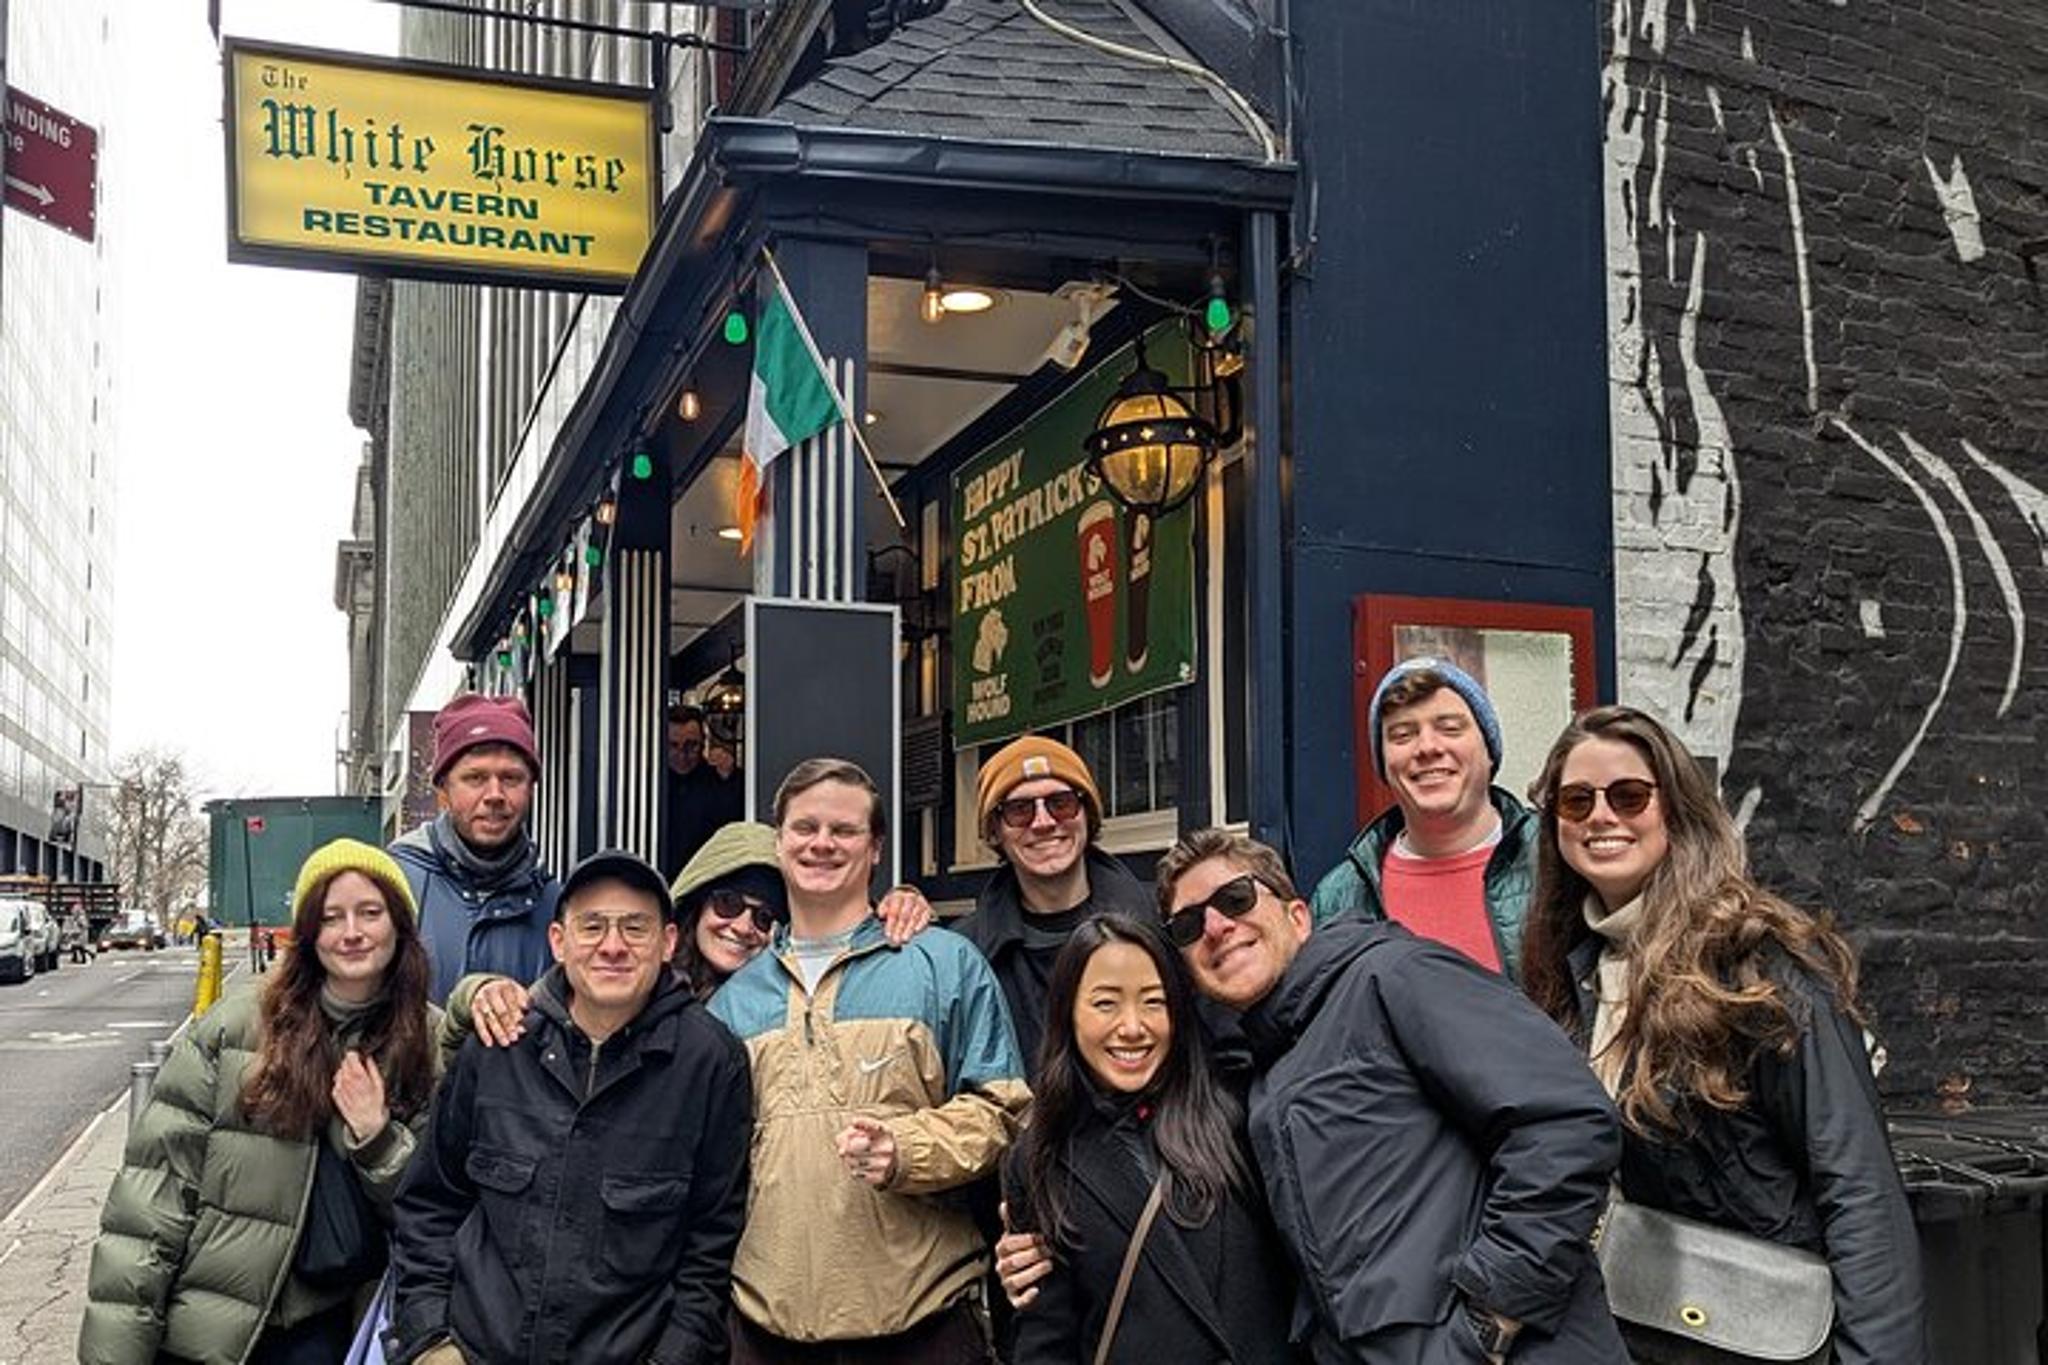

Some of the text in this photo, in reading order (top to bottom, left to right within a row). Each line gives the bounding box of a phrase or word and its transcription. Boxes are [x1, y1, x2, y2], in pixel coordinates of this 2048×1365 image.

[261, 64, 309, 92] The
[261, 98, 626, 194] White Horse
[363, 181, 539, 220] TAVERN
[302, 208, 596, 258] RESTAURANT
[960, 553, 1017, 614] FROM
